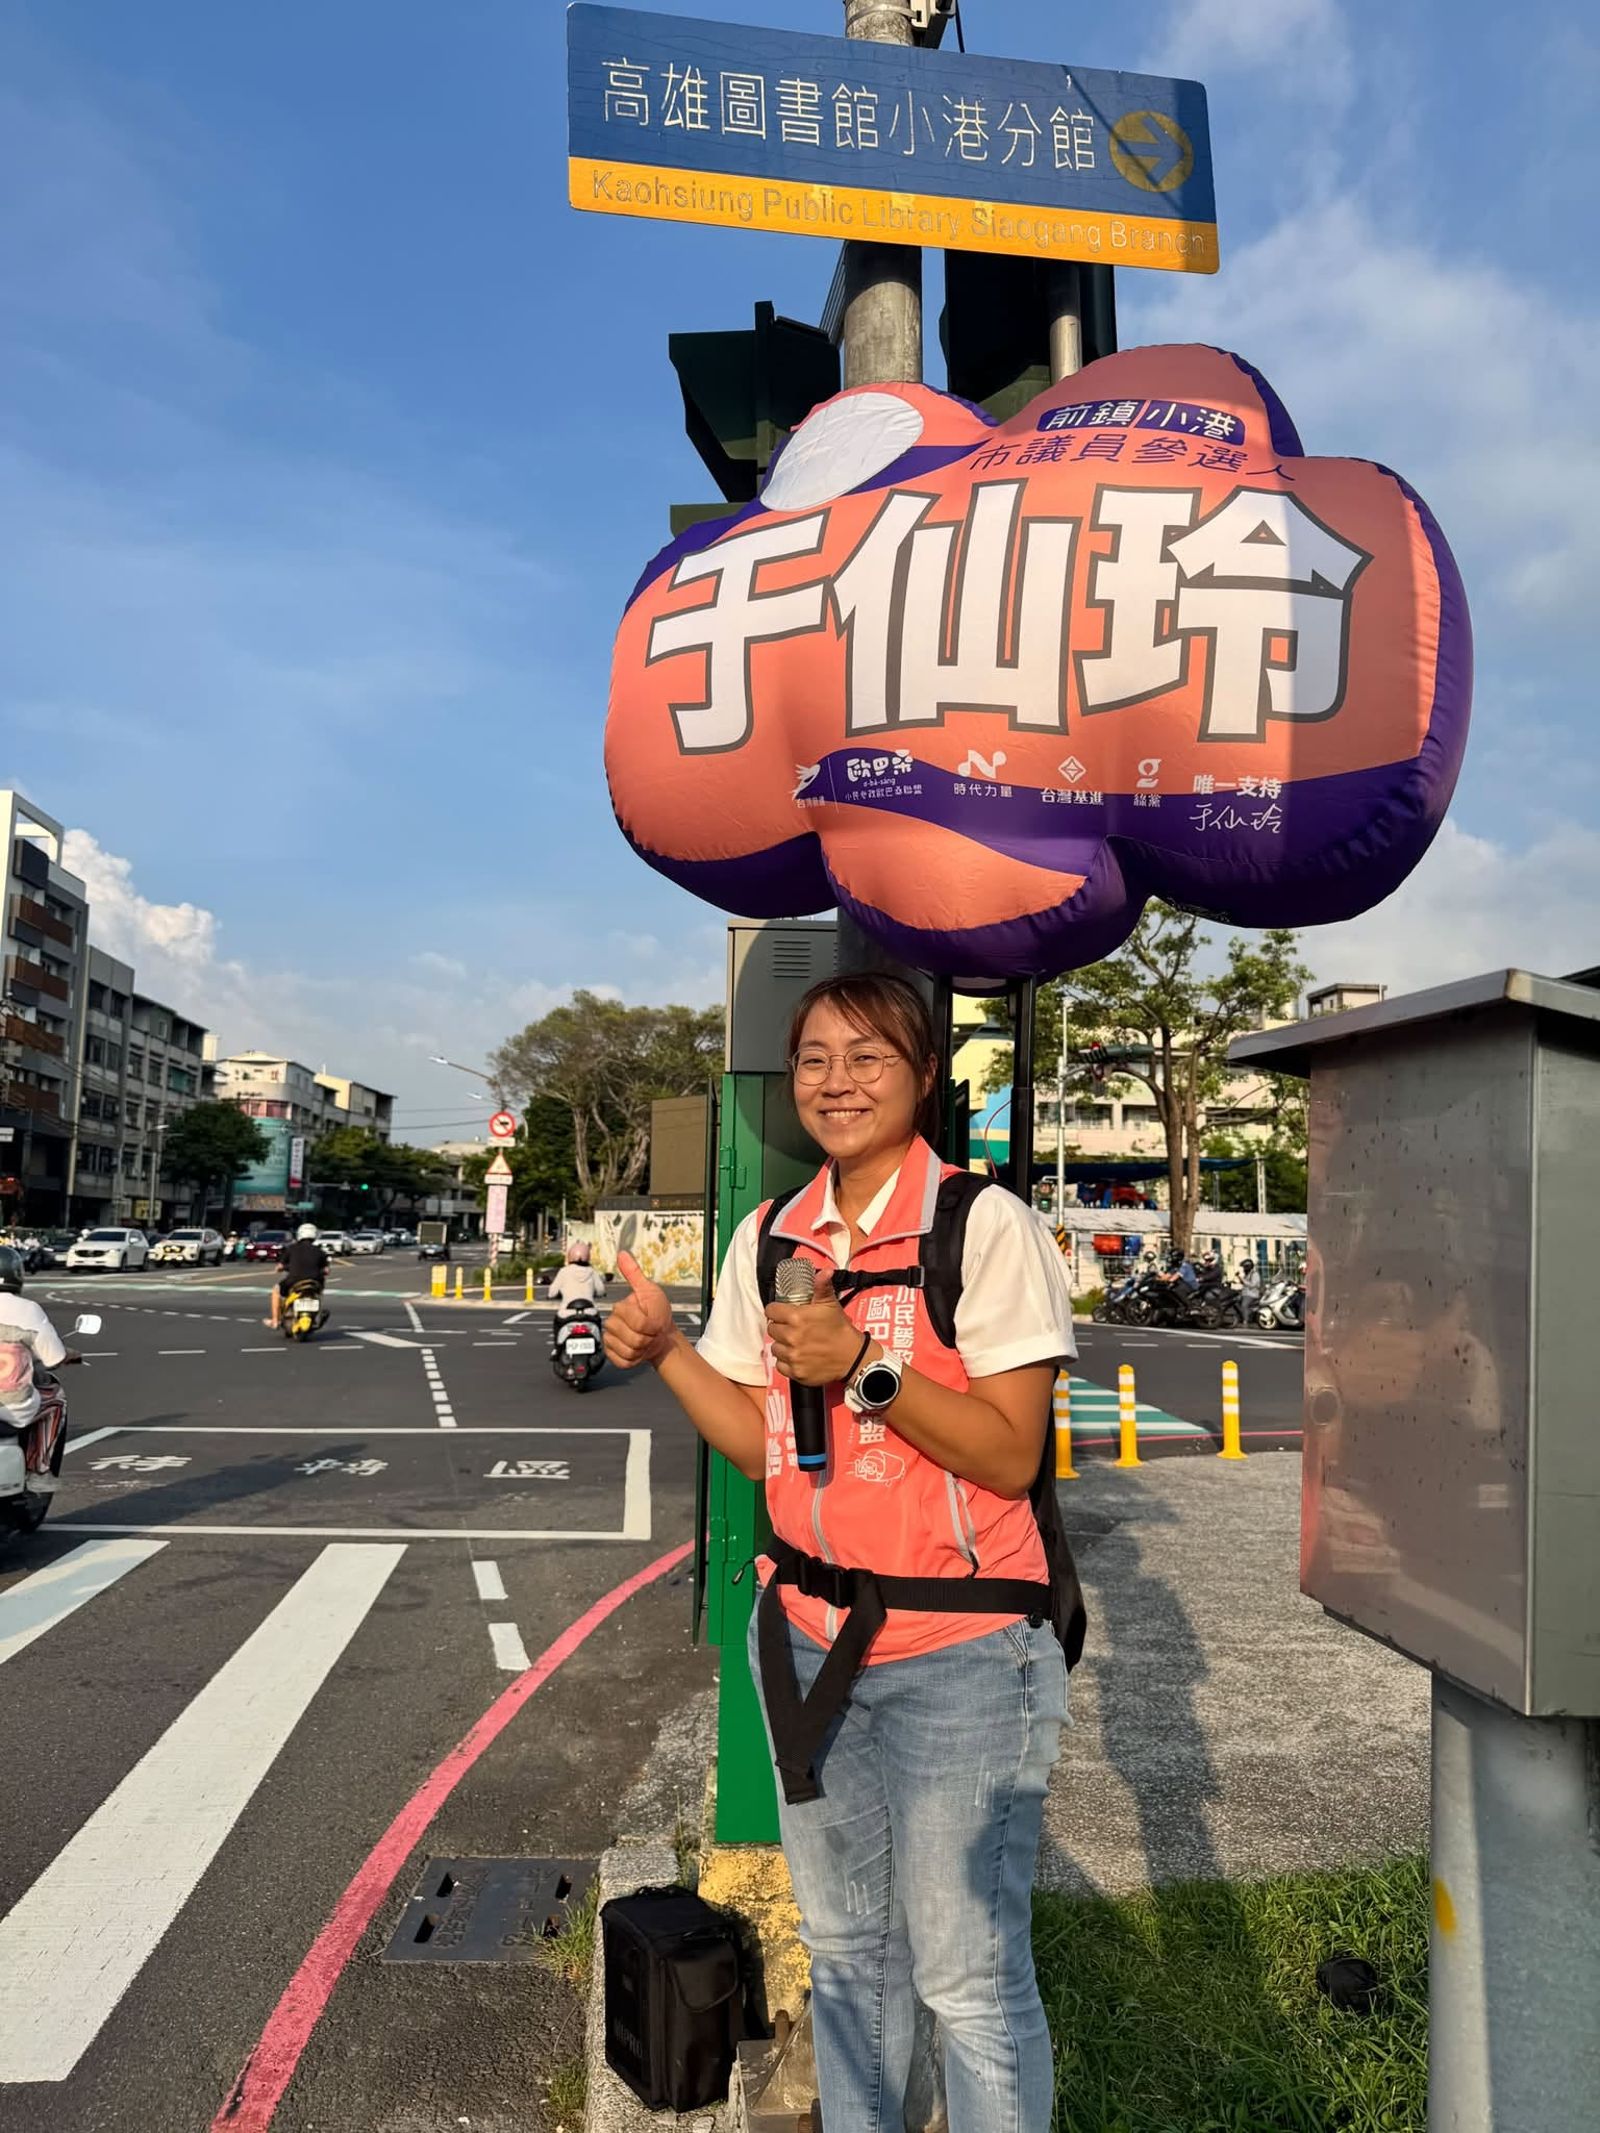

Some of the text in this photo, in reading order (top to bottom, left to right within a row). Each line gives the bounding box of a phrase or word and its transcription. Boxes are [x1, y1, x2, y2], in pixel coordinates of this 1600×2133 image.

[601, 56, 1096, 171] 高雄圖書館小港分館
[593, 169, 1206, 255] Kaohsiung Public Library Siaogang Branch
[1046, 399, 1237, 441] 前鎮 小港
[968, 433, 1296, 482] 市議員參選人
[645, 477, 1375, 756] 于仙玲
[954, 782, 1013, 798] 時代力量
[1040, 788, 1104, 806] 台灣基進
[1193, 774, 1282, 799] 唯一支持
